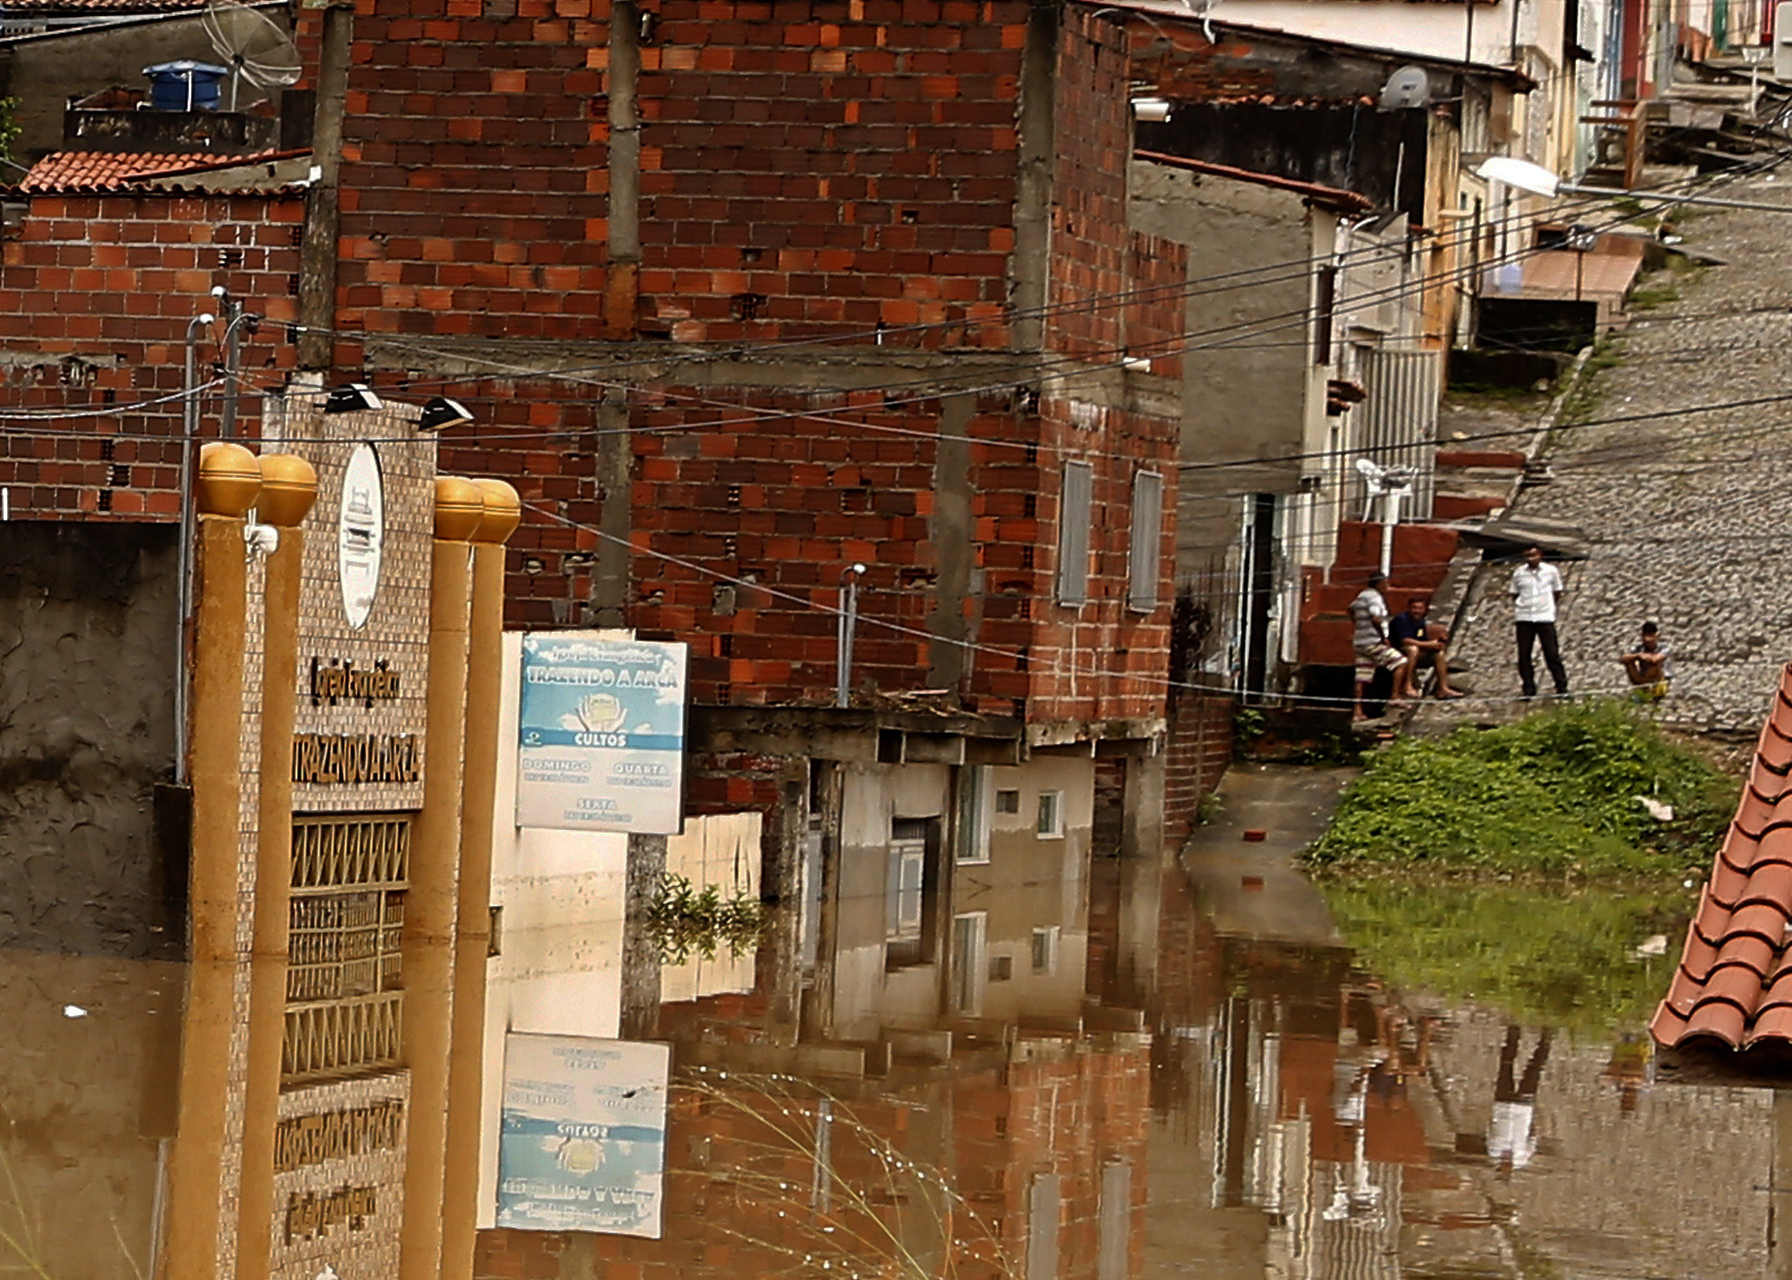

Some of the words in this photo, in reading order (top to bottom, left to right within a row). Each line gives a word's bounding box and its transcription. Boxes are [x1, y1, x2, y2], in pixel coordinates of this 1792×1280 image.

[528, 666, 614, 687] TRAZENDO
[617, 670, 631, 686] A
[634, 669, 678, 689] ARCA
[574, 732, 627, 747] CULTOS
[289, 733, 368, 783] TRAZENDO
[381, 733, 419, 783] ARCA
[521, 758, 591, 773] DOMINGO
[613, 762, 668, 776] QUARTA
[577, 798, 619, 811] SEXTA
